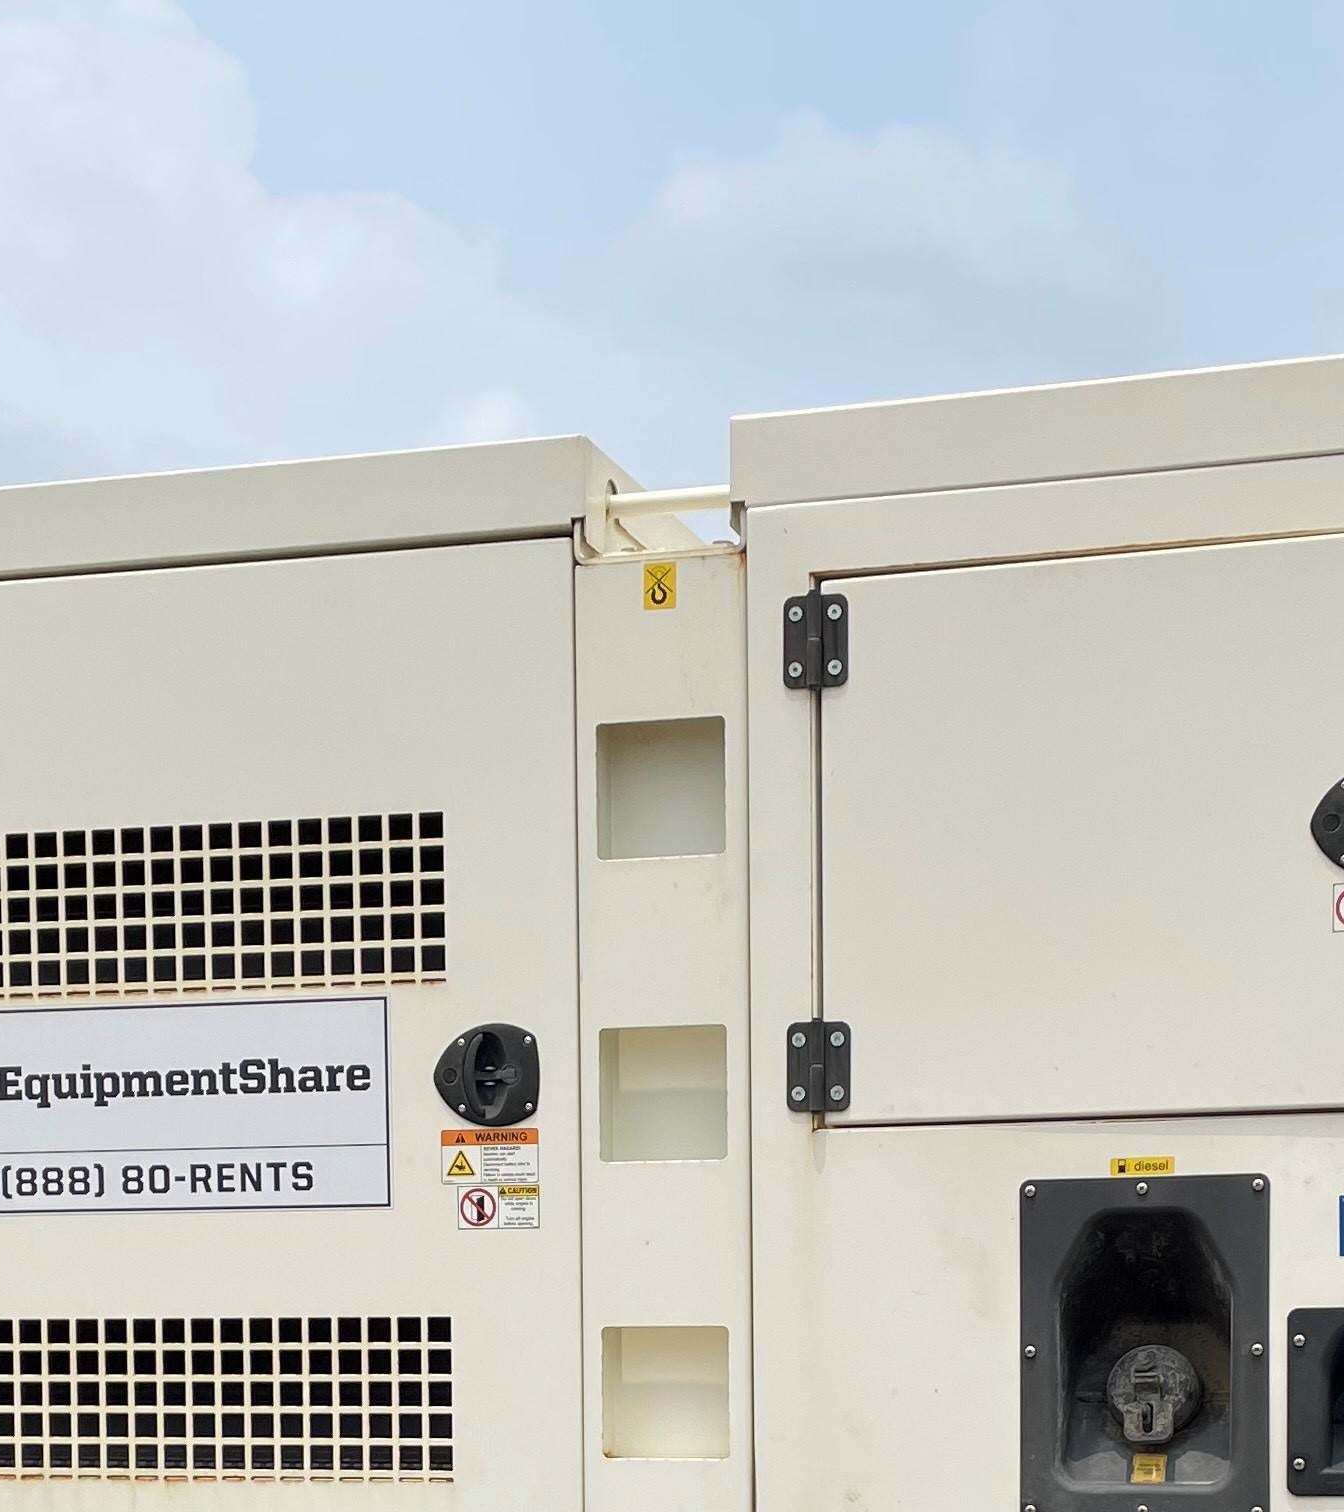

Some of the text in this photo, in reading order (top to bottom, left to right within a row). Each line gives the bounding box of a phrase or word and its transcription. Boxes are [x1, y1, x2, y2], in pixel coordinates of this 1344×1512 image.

[475, 1131, 528, 1142] WARNING
[1134, 1160, 1169, 1172] diesel
[0, 1161, 315, 1200] (888) 80-RENTS
